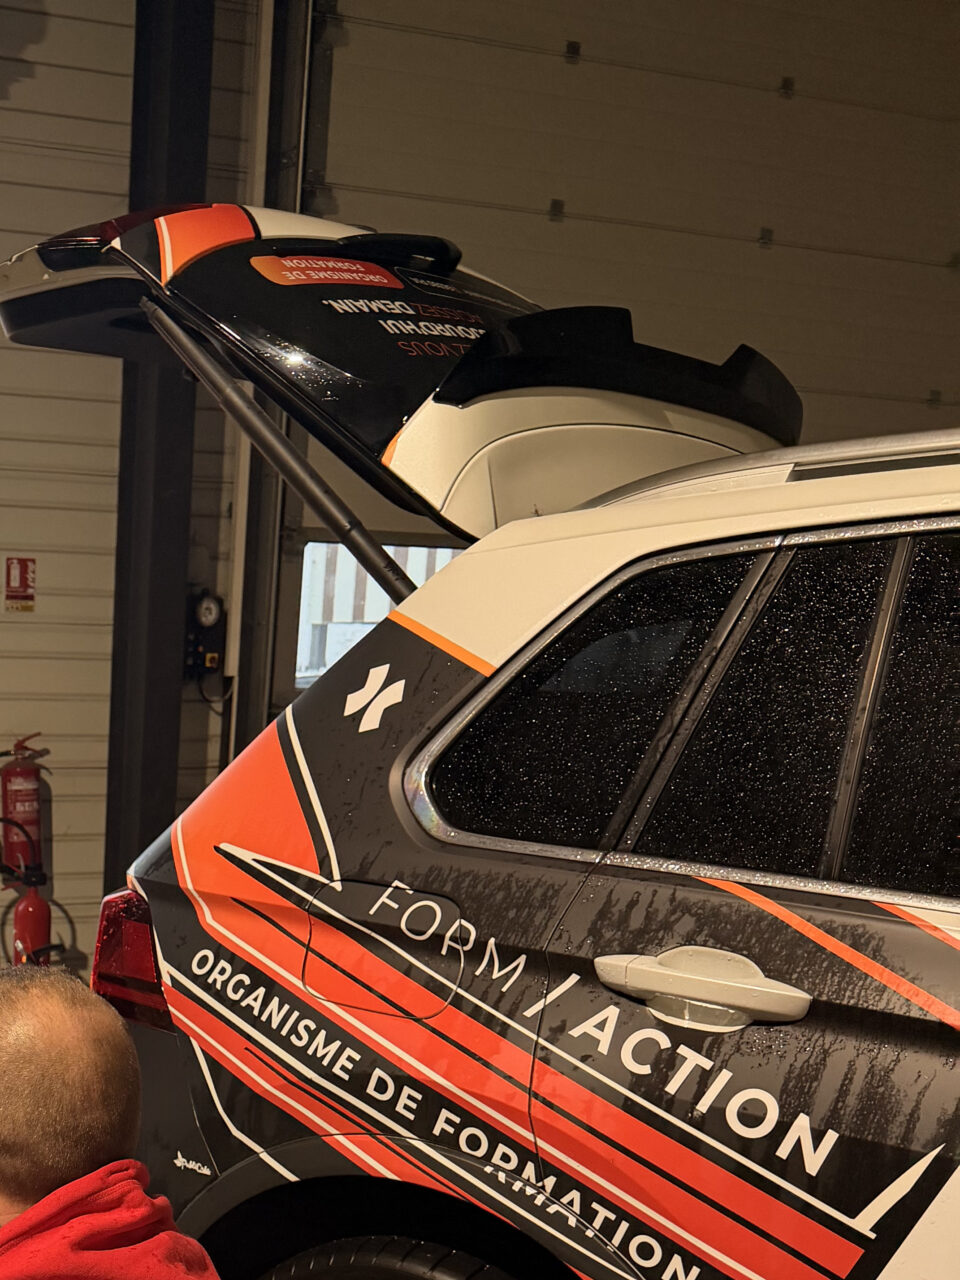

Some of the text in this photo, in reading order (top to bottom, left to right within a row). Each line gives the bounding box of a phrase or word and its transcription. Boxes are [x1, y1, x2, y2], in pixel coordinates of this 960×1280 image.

[281, 258, 364, 272] FORMATION
[282, 269, 389, 284] ORGANISME DE
[321, 298, 416, 316] DEMAIN.
[396, 340, 460, 357] VOUS
[190, 948, 362, 1083] ORGANISME
[365, 1067, 423, 1121] DE
[369, 878, 527, 993] FORM
[569, 1004, 840, 1176] ACTION
